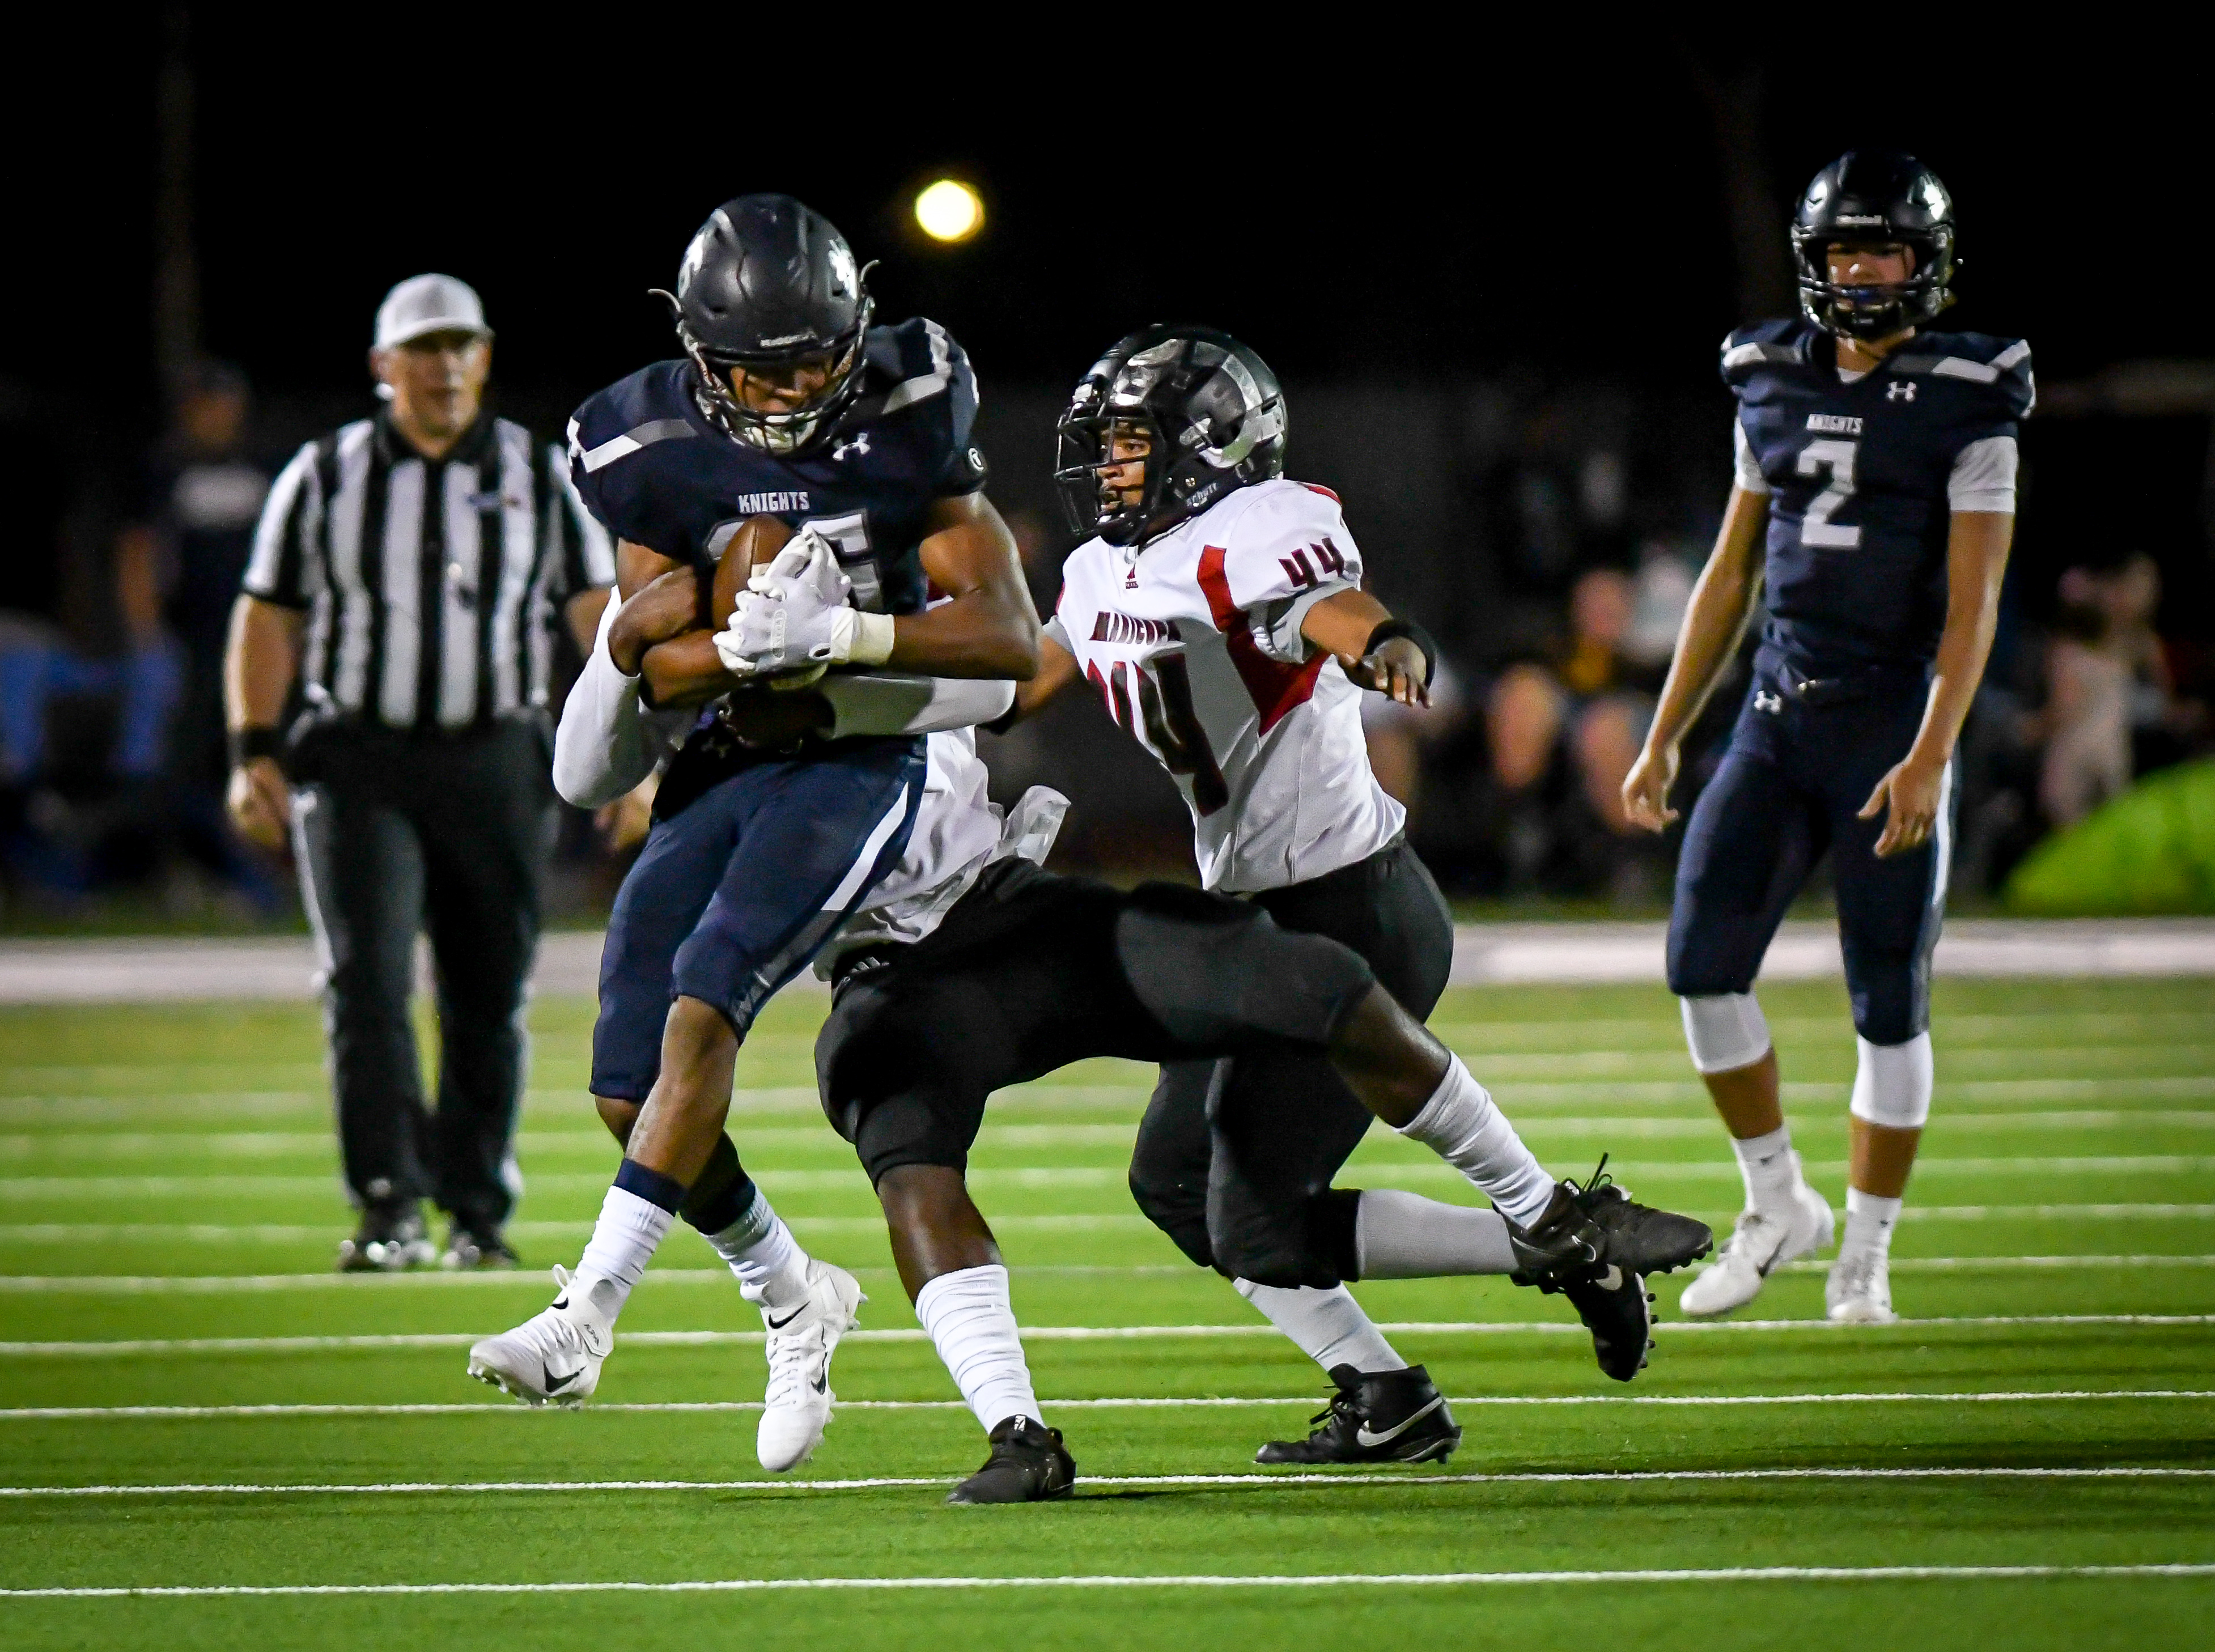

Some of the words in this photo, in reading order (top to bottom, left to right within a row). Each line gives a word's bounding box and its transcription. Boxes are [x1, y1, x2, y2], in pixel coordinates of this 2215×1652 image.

[739, 491, 810, 513] KNIGHTS
[1798, 440, 1861, 547] 2
[1277, 537, 1346, 588] 44
